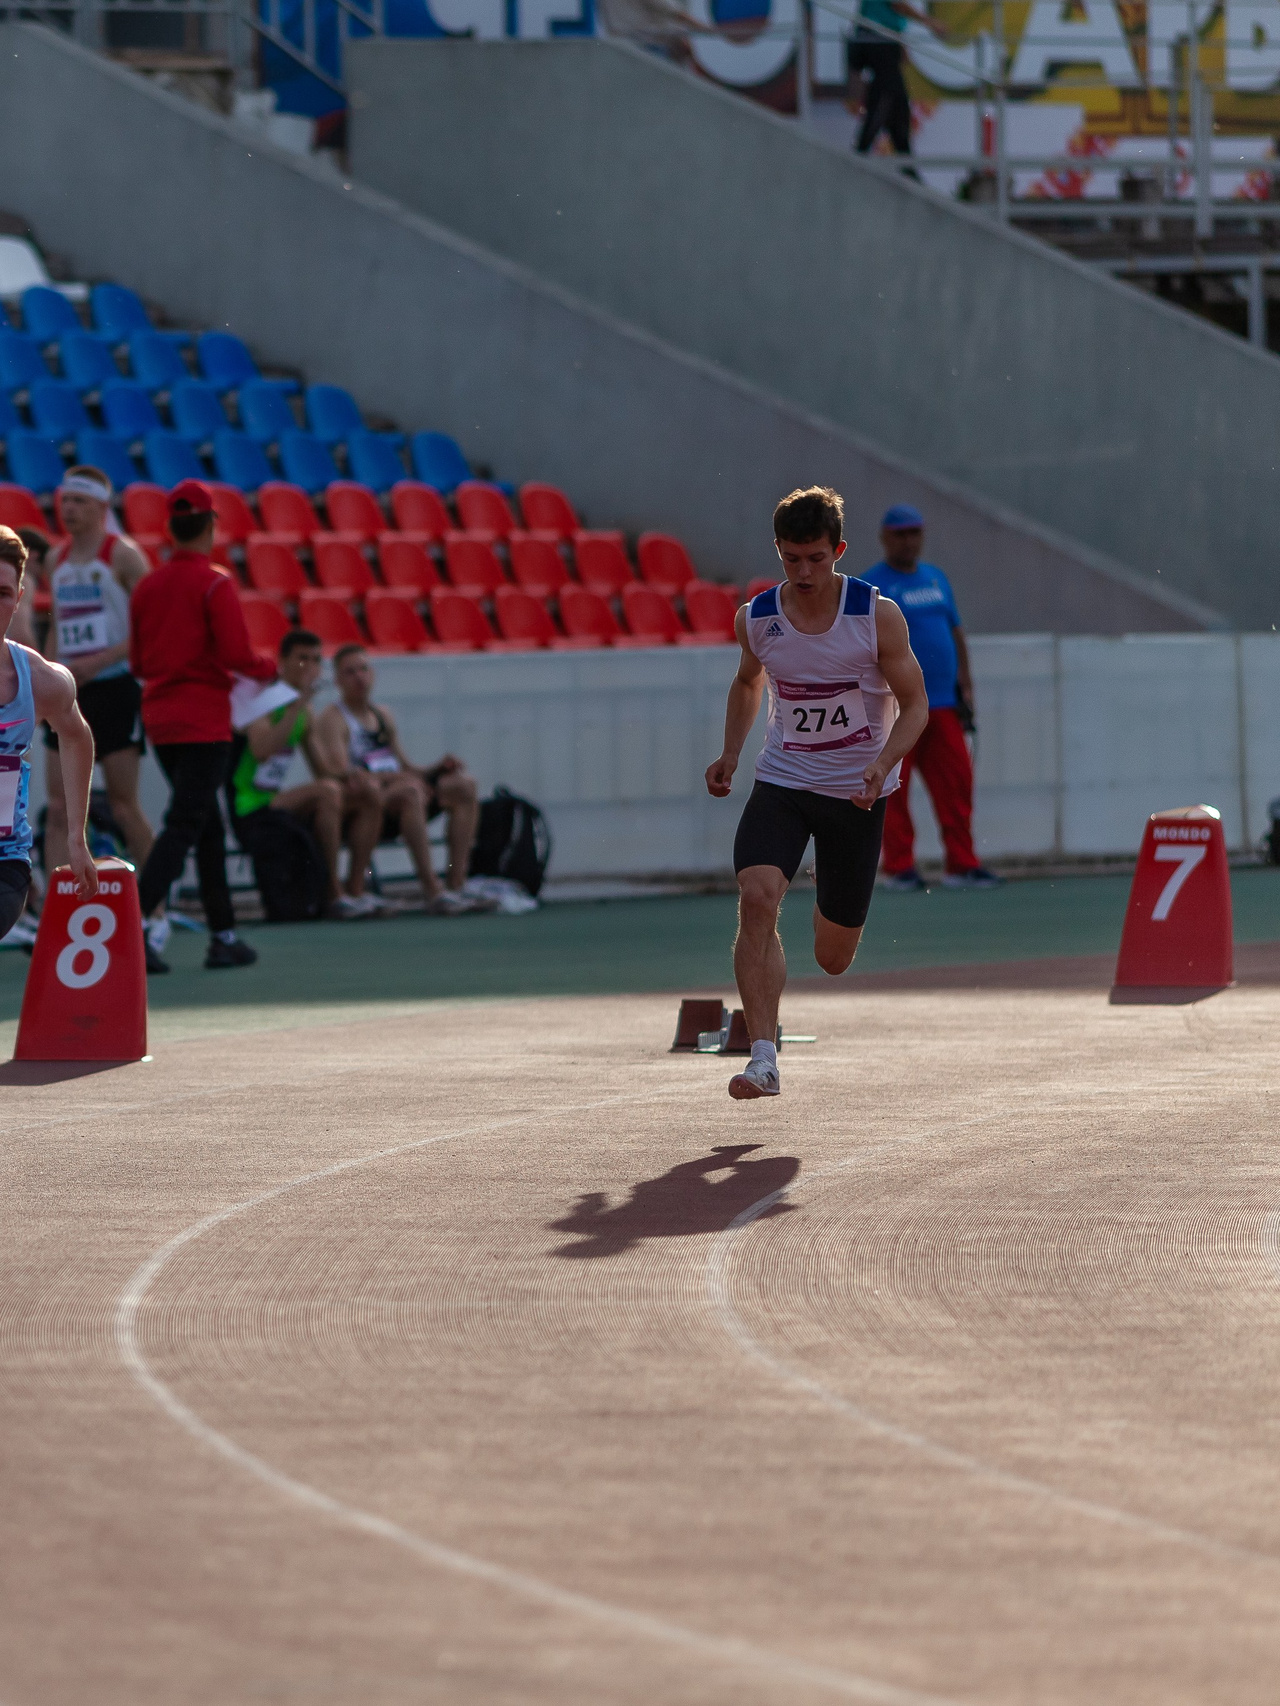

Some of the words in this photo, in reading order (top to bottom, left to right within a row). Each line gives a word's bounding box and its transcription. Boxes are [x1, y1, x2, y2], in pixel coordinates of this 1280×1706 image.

[792, 704, 849, 733] 274
[1153, 826, 1211, 841] MONDO
[57, 881, 122, 895] MDO
[1151, 844, 1208, 921] 7
[56, 903, 118, 989] 8
